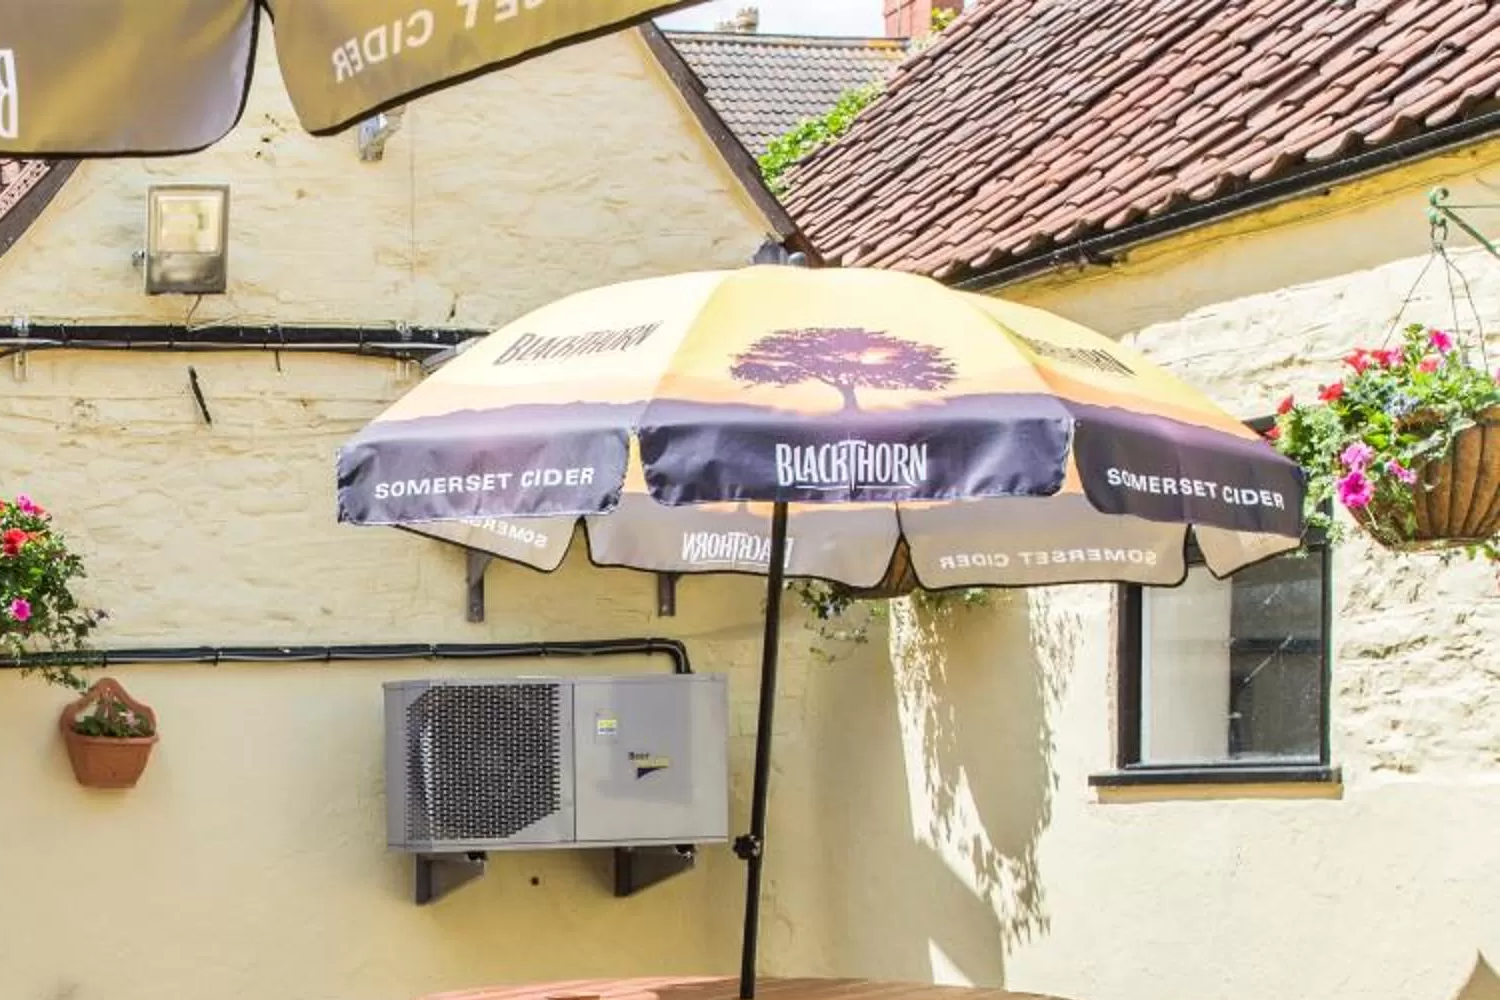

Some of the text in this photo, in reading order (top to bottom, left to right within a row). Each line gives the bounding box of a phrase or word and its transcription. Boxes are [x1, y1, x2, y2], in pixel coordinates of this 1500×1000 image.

[492, 320, 664, 366] BLACKTHORN
[374, 467, 595, 499] SOMERSET CIDER
[775, 439, 928, 491] BLACKTHORN
[1106, 467, 1285, 510] SOMERSET CIDER
